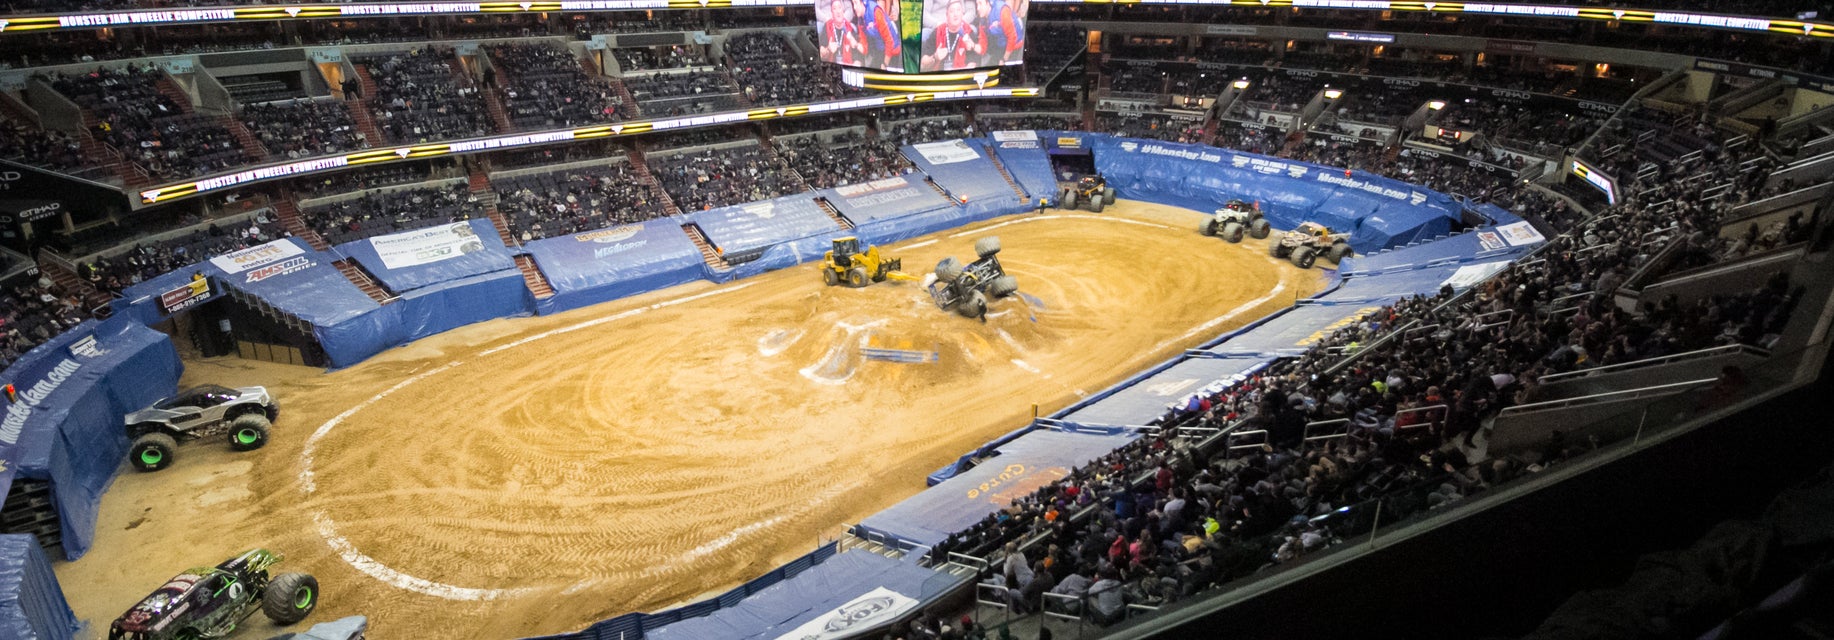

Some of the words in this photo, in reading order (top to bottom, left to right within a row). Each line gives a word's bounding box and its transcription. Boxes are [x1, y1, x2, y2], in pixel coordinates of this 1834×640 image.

[59, 15, 107, 26] MONSTER
[110, 14, 129, 24] JAM
[130, 12, 173, 22] WHEELIE
[1492, 89, 1531, 100] ETIHAD
[1578, 101, 1616, 113] ETIHAD
[196, 175, 236, 191] MONSTER
[237, 171, 254, 182] JAM
[254, 165, 292, 179] WHEELIE
[293, 156, 348, 172] COMPETITION
[20, 203, 60, 217] ETIHAD
[226, 244, 275, 259] Nationwide
[235, 255, 256, 264] 4G
[256, 247, 282, 258] LTE
[246, 256, 309, 283] AMSOIL
